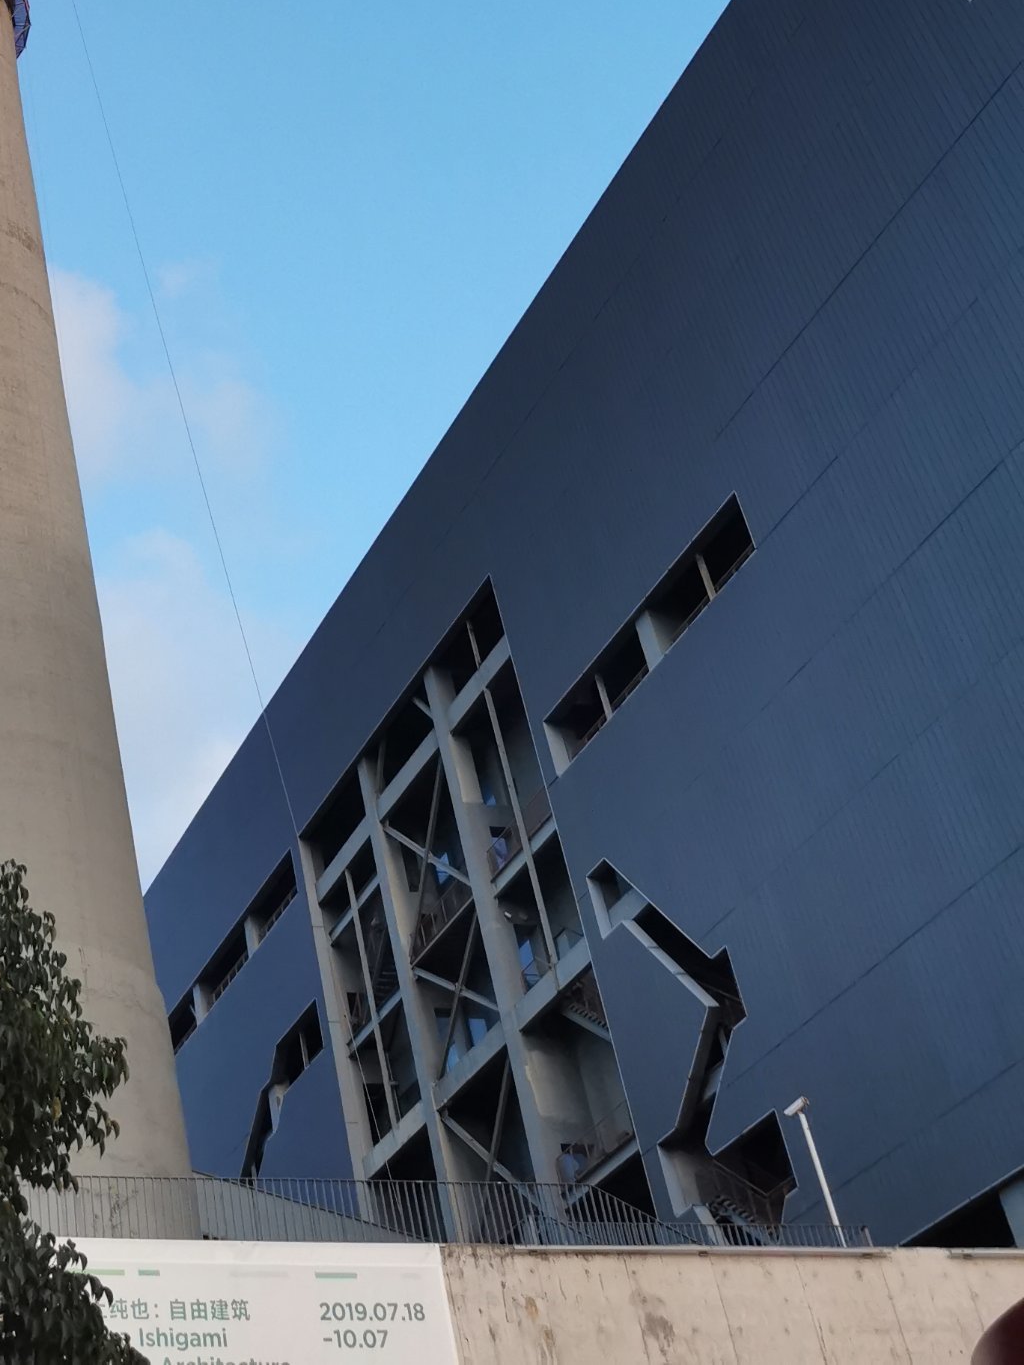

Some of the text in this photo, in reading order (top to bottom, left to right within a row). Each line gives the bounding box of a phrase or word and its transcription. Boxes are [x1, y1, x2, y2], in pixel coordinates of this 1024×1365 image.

[319, 1302, 426, 1321] 2019.07.18
[139, 1328, 228, 1351] Ishigami
[322, 1329, 388, 1349] -10.07
